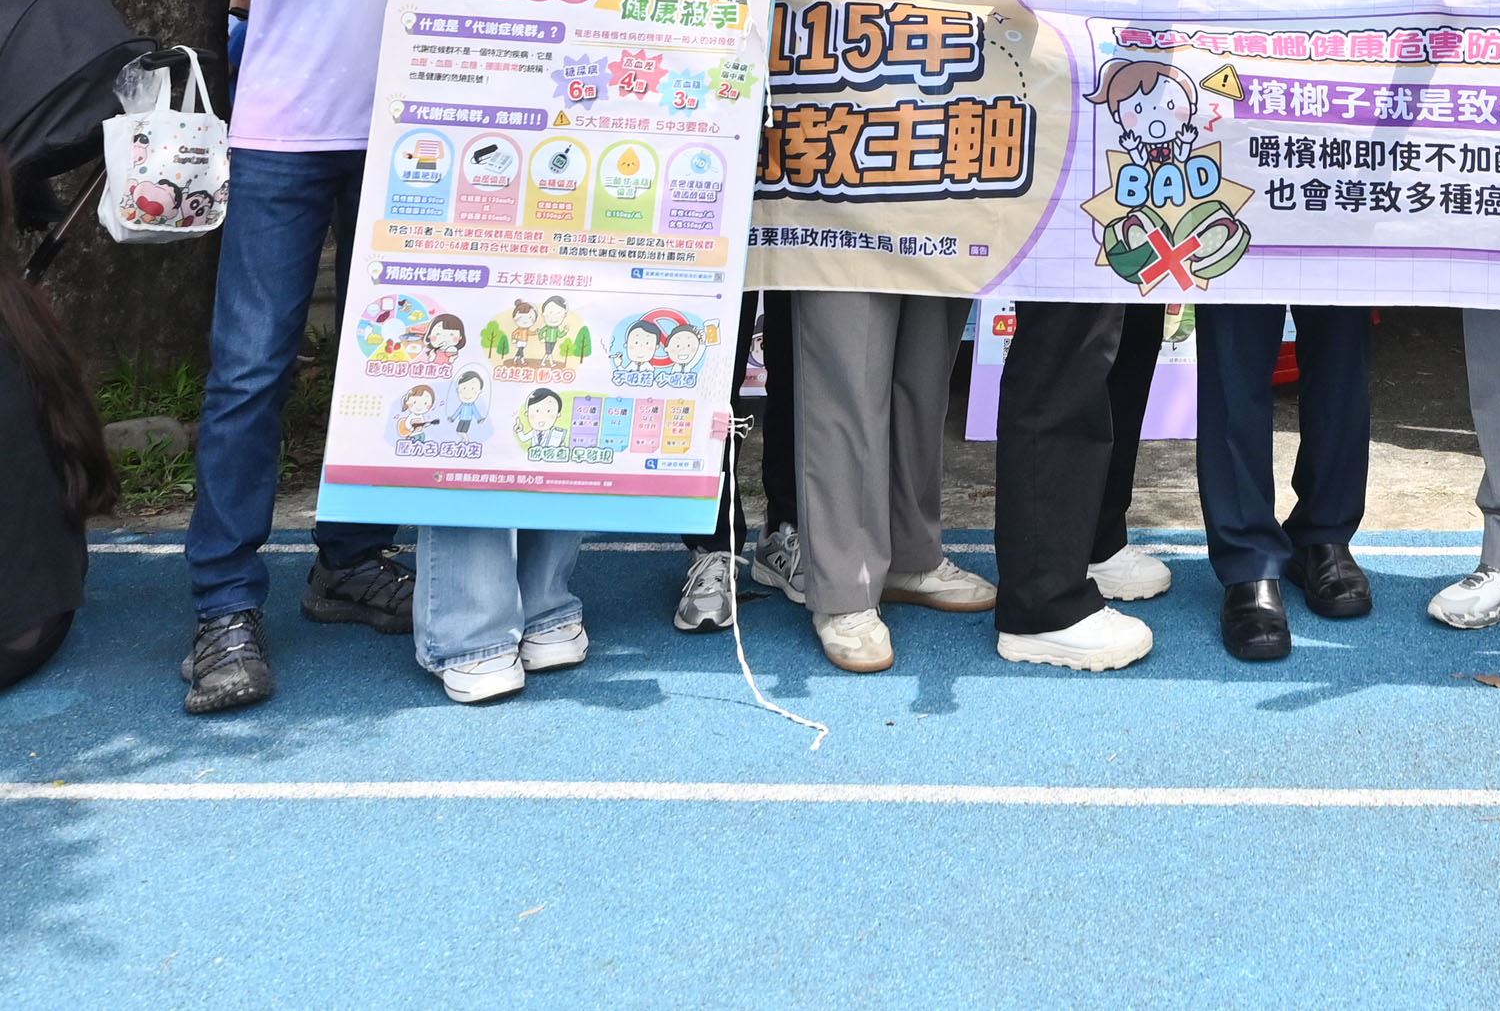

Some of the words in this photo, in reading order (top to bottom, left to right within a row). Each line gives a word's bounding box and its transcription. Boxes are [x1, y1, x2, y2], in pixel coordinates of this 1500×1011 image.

[768, 1, 985, 86] 115年
[569, 80, 596, 100] 6倍
[1115, 154, 1221, 208] BAD
[747, 227, 893, 253] 苗栗縣政府衛生局
[899, 236, 958, 256] 關心您
[385, 265, 482, 284] 預防代謝症候群
